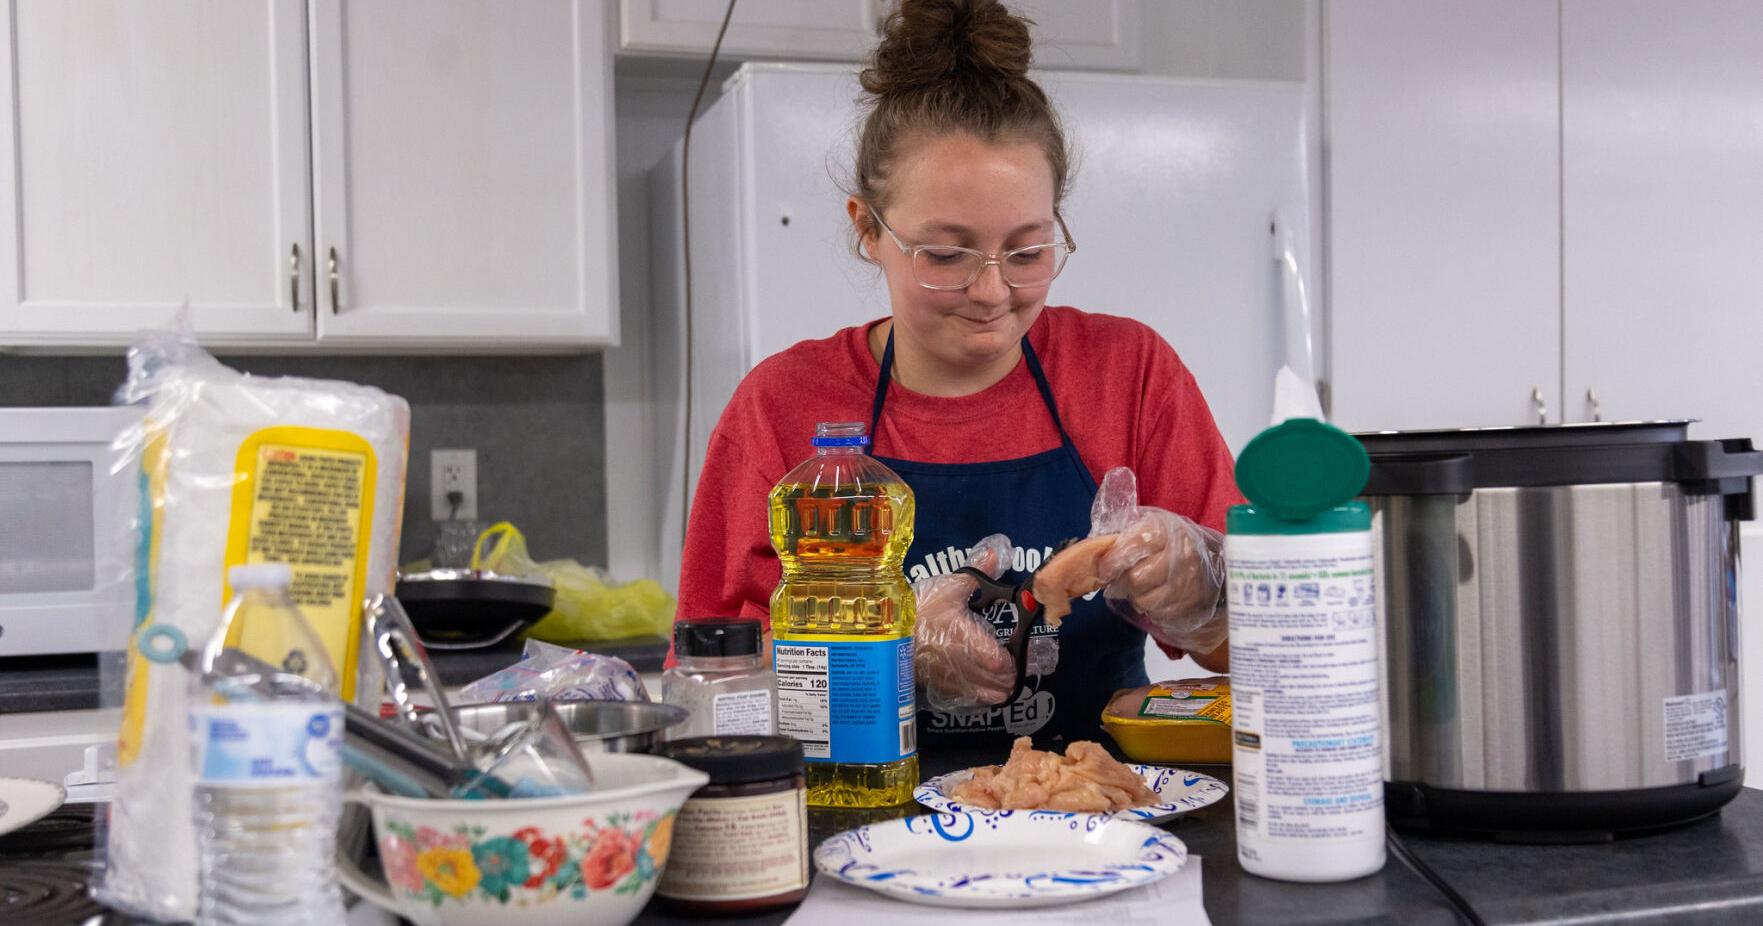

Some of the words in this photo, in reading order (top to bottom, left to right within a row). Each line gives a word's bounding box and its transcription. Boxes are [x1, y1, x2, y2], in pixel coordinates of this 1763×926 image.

[776, 647, 805, 656] Nutrition
[806, 648, 827, 657] Facts
[777, 680, 803, 688] Calories
[810, 679, 828, 689] 120
[1010, 699, 1039, 723] Ed
